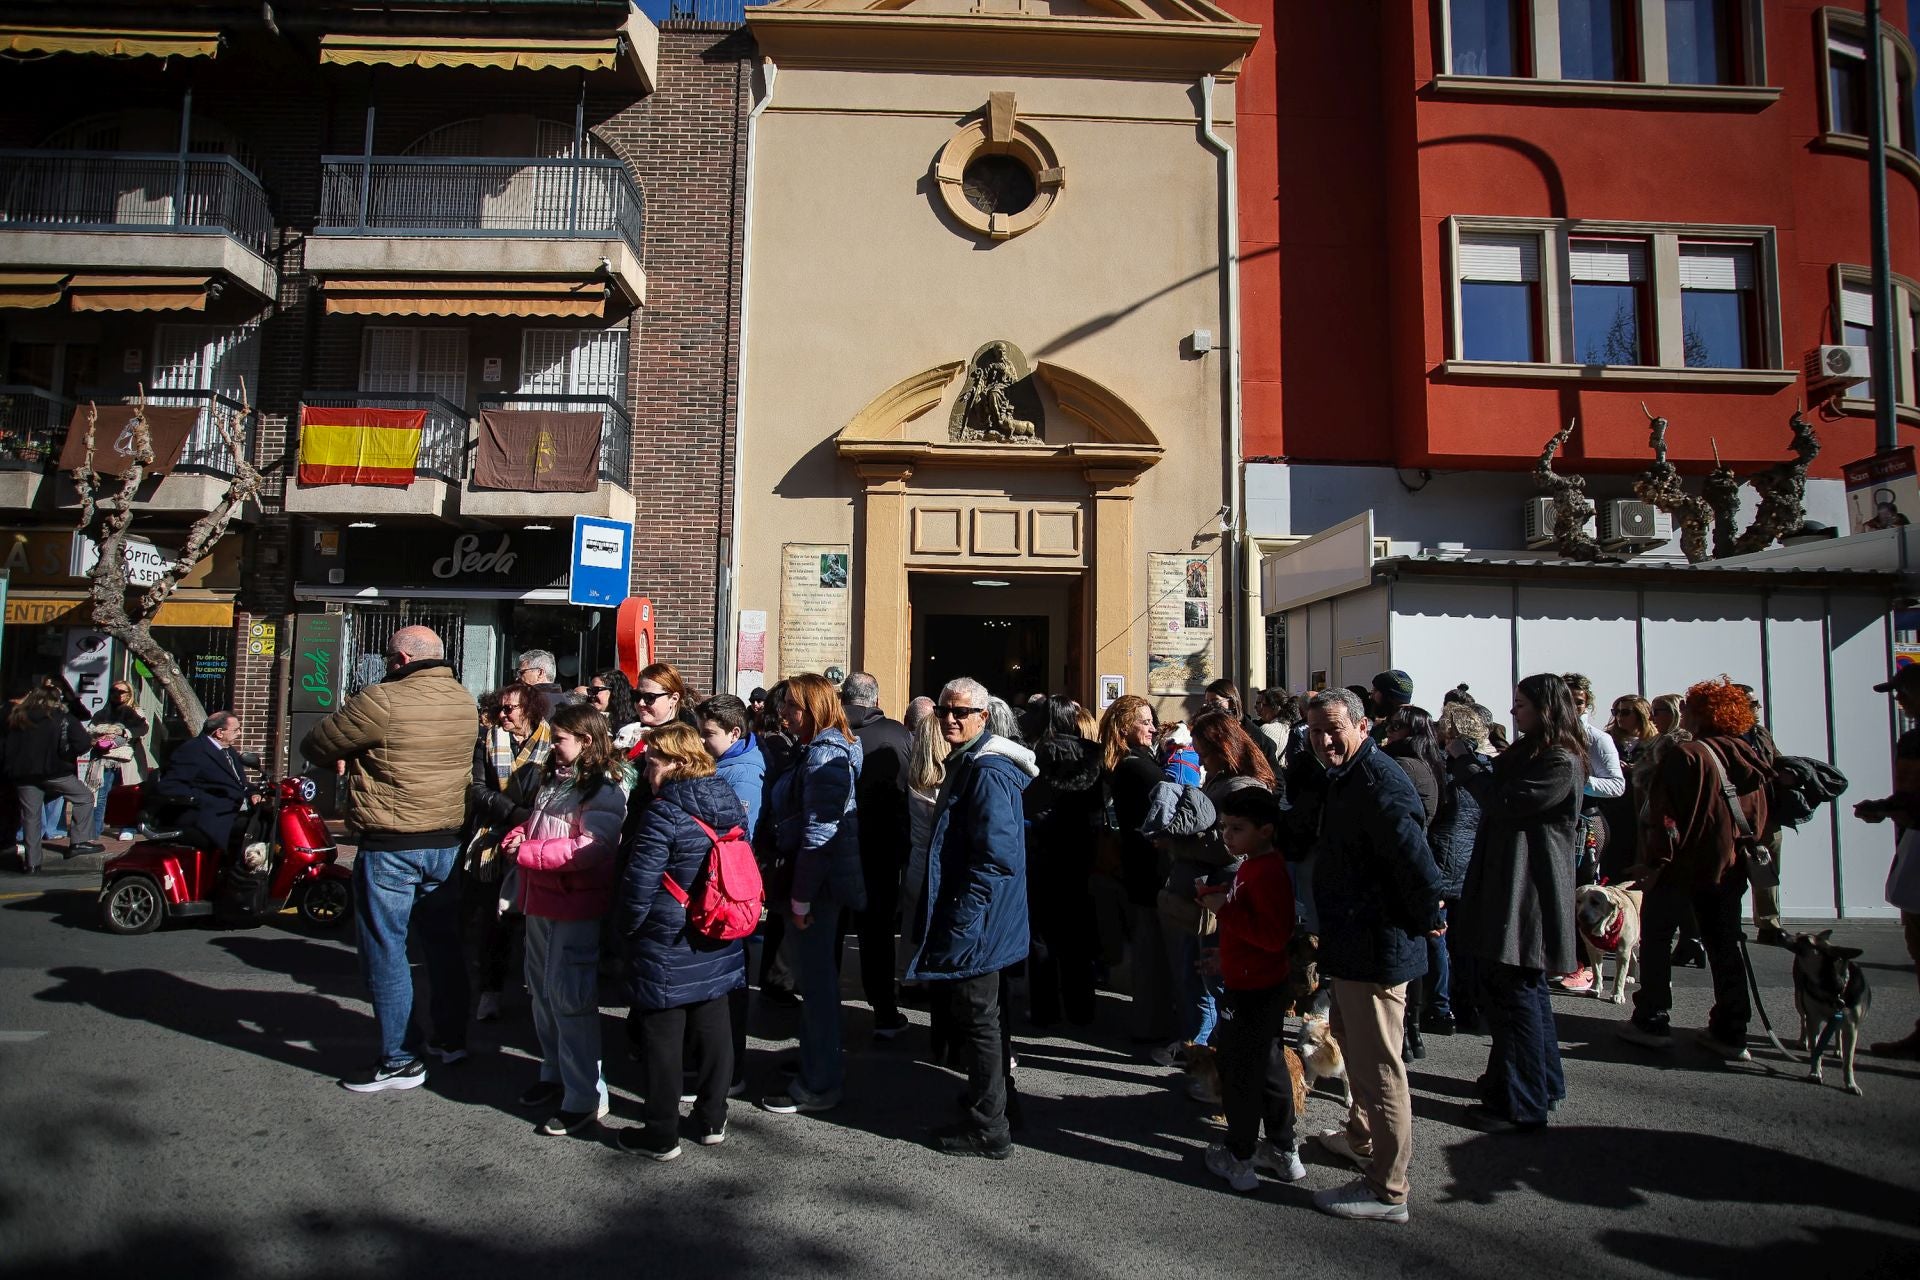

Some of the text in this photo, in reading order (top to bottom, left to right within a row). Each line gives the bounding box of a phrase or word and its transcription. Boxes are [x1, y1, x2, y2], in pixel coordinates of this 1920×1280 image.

[124, 545, 168, 568] ÓPTICA
[431, 532, 519, 579] Seda
[139, 568, 165, 583] SED
[78, 673, 99, 694] E
[301, 647, 333, 707] Seda
[91, 697, 103, 709] P
